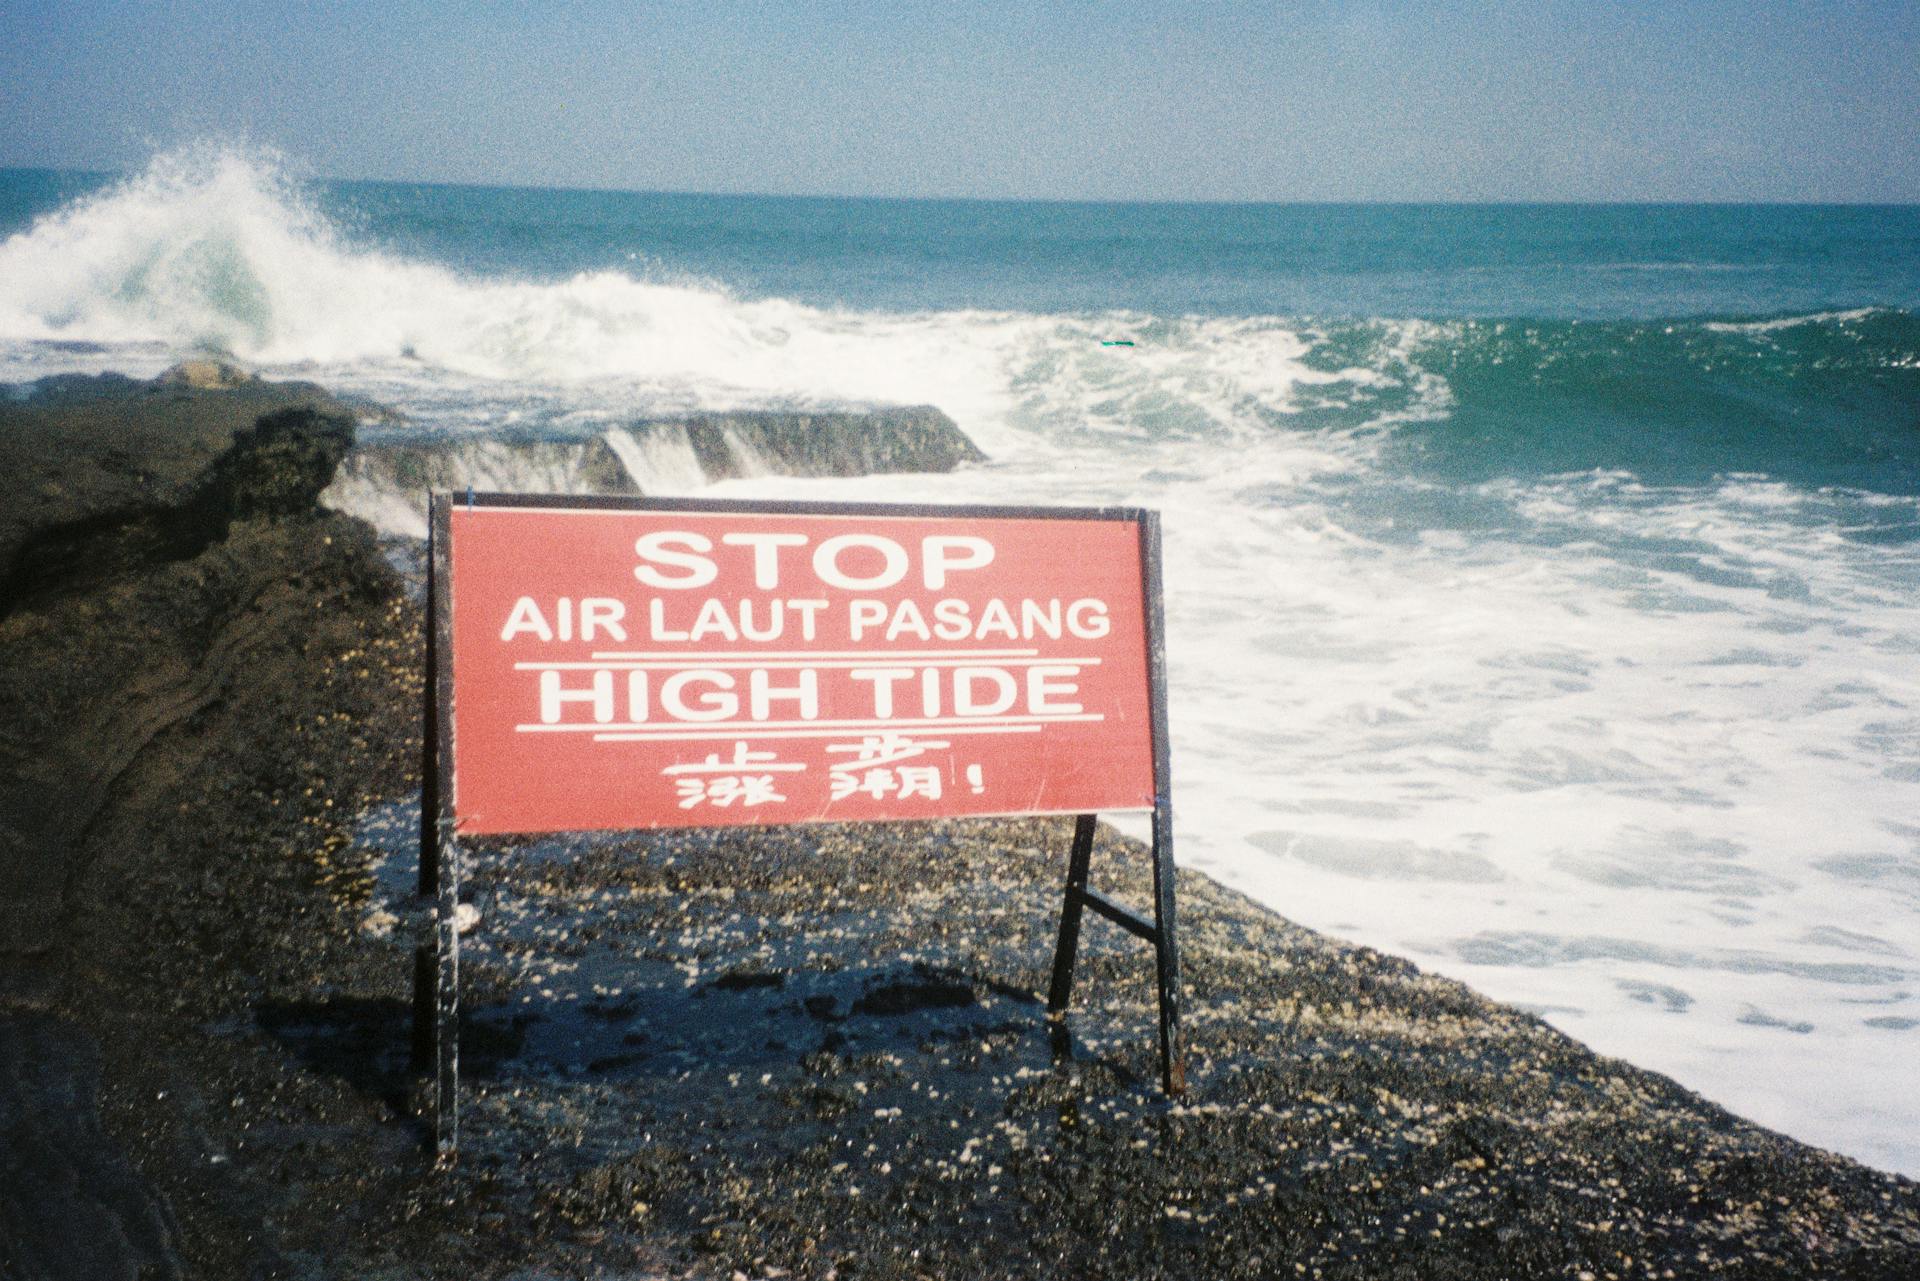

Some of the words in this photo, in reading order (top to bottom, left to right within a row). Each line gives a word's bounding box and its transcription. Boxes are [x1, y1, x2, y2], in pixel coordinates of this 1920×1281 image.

[633, 530, 996, 591] STOP
[500, 596, 628, 643] AIR
[649, 597, 831, 643] LAUT
[850, 597, 1112, 642] PASANG
[540, 668, 820, 724] HIGH
[849, 666, 1085, 719] TIDE
